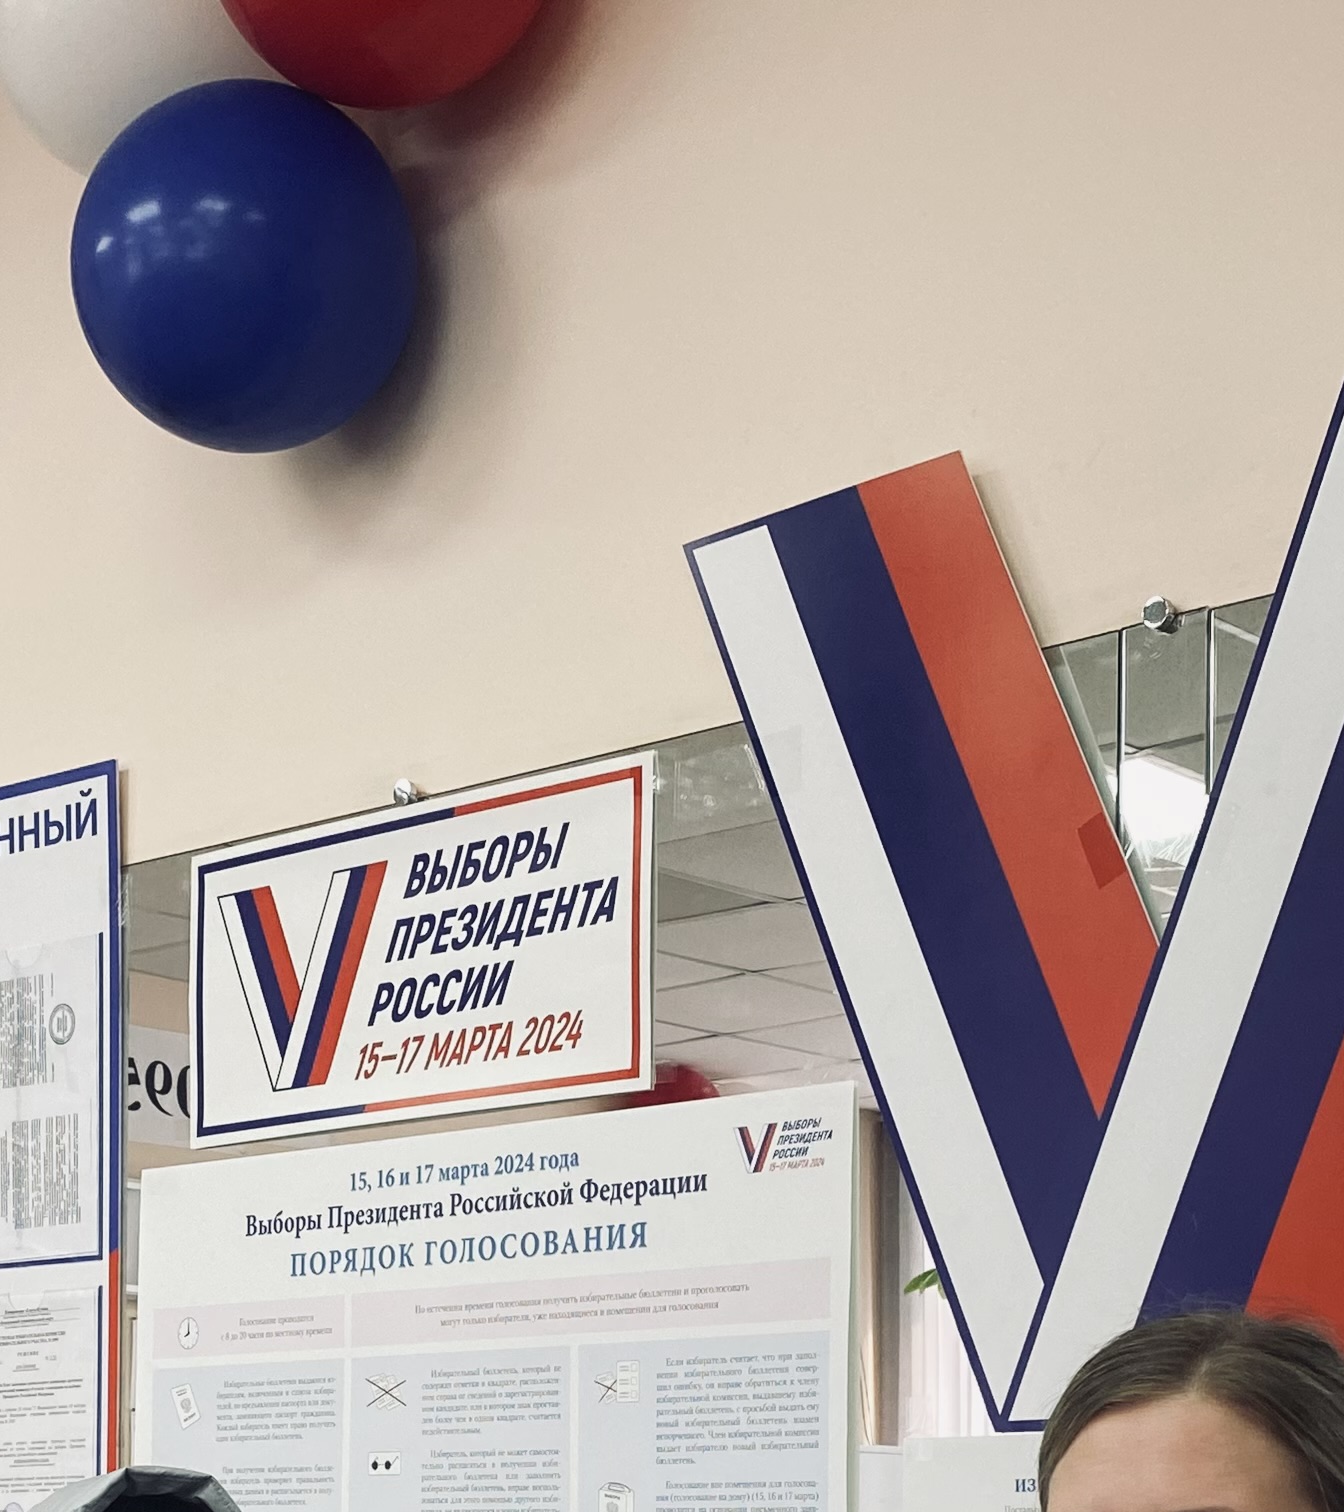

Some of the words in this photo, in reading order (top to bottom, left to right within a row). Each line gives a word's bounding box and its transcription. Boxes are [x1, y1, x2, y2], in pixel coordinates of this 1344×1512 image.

[403, 822, 570, 899] ВЫБОРЫ
[385, 877, 619, 964] ПРЕЗИДЕНТА
[369, 961, 514, 1027] РОССИИ
[427, 1026, 513, 1069] МАРТА
[517, 1010, 583, 1056] 2024
[777, 1130, 833, 1145] ПРЕЗИДЕНТА
[782, 1117, 822, 1131] ВЫБОРЫ
[349, 1172, 372, 1195] 15,
[377, 1169, 394, 1190] 16
[399, 1172, 411, 1188] и
[415, 1165, 434, 1185] 17
[438, 1162, 489, 1186] марта
[494, 1154, 535, 1177] 2024
[540, 1150, 580, 1176] года
[773, 1146, 809, 1159] РОССИИ
[788, 1160, 808, 1168] МАРТА
[809, 1158, 824, 1167] 2024
[246, 1205, 322, 1237] Выборы
[328, 1198, 444, 1232] Президента
[450, 1181, 574, 1220] Российской
[580, 1170, 708, 1207] Федерации
[290, 1241, 415, 1278] ПОРЯДОК
[425, 1221, 649, 1267] ГОЛОСОВАНИЯ
[415, 1305, 425, 1314] По
[427, 1304, 463, 1313] истечении
[465, 1302, 493, 1312] времени
[496, 1299, 541, 1309] голосования
[543, 1296, 578, 1306] получить
[580, 1292, 637, 1303] избирательные
[639, 1289, 682, 1299] бюллетени
[691, 1284, 750, 1296] проголосовать
[440, 1318, 460, 1328] могут
[463, 1317, 486, 1325] только
[533, 1312, 547, 1321] уже
[549, 1308, 598, 1319] находящиеся
[606, 1306, 651, 1316] помещении
[653, 1305, 666, 1313] для
[669, 1301, 719, 1312] голосования
